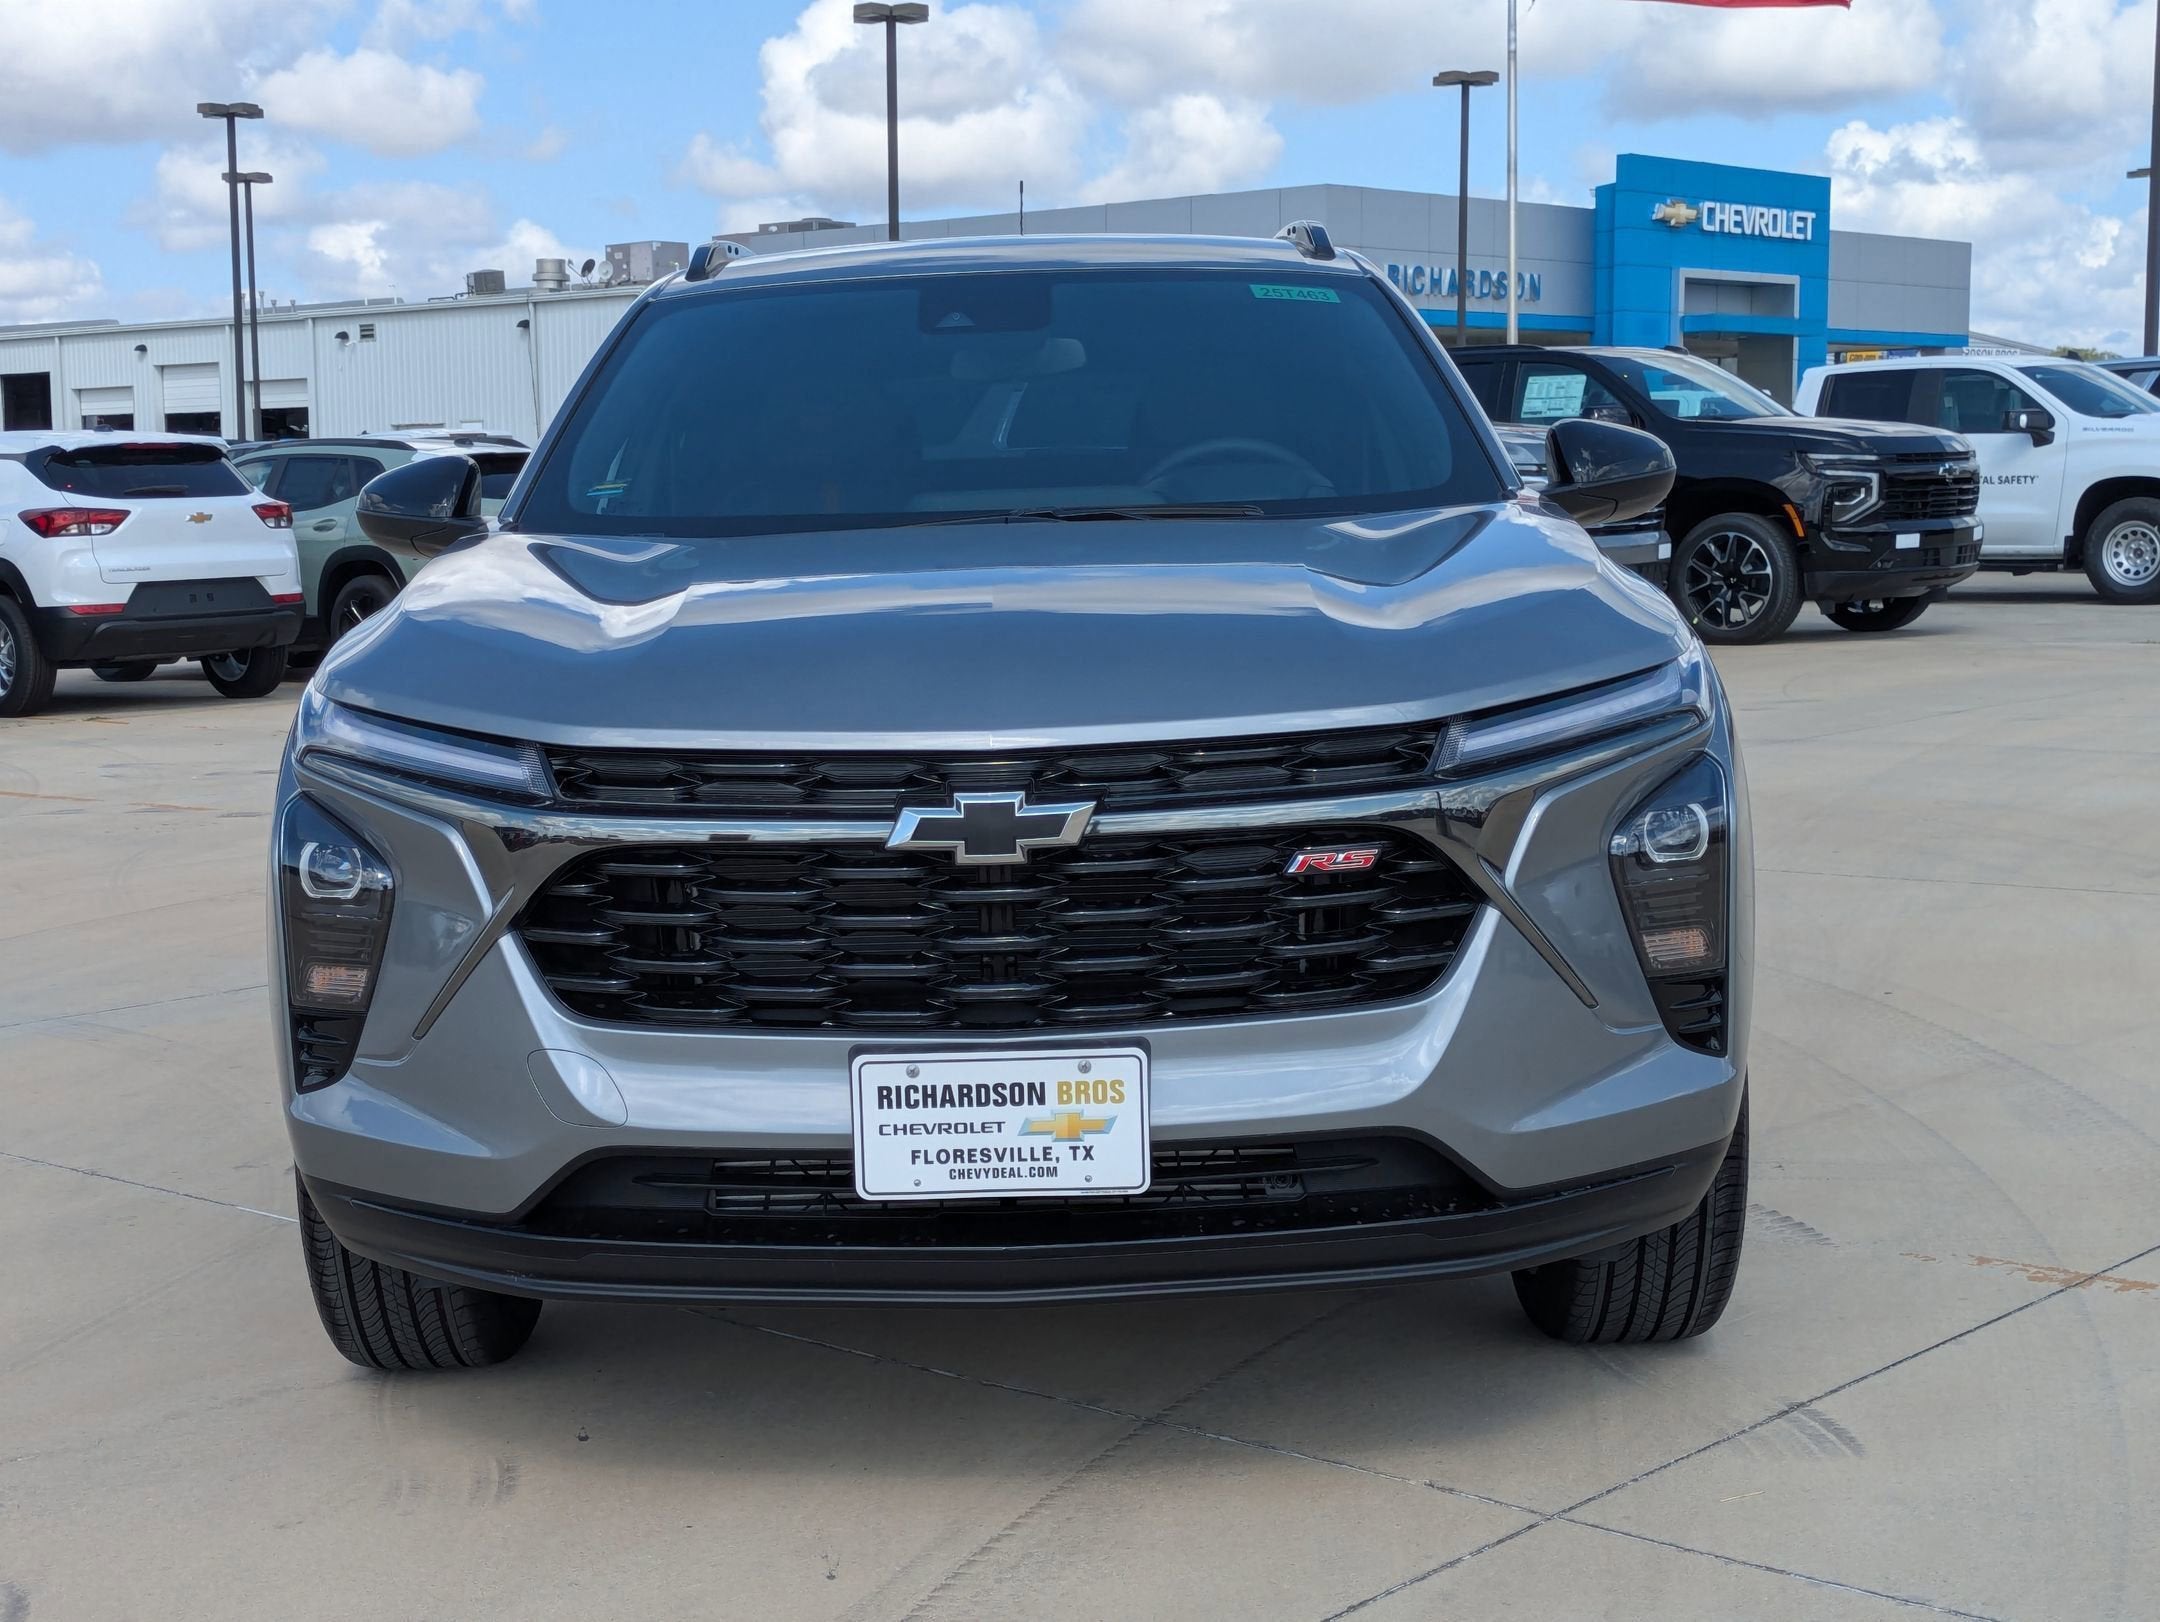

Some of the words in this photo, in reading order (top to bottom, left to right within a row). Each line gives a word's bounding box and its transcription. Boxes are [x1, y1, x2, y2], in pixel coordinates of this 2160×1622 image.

[1702, 200, 1816, 241] CHEVROLET
[1260, 287, 1331, 301] 25T463
[1980, 475, 1995, 485] AL
[1997, 475, 2036, 485] SAFETY
[1287, 849, 1379, 873] RS
[877, 1082, 1046, 1109] RICHARDSON
[1057, 1079, 1126, 1105] BROS
[879, 1121, 1006, 1136] CHEVROLET
[911, 1146, 1060, 1165] FLORESVILLE,
[1069, 1145, 1095, 1161] TX
[949, 1166, 1058, 1180] CHEVYDEAL.COM
